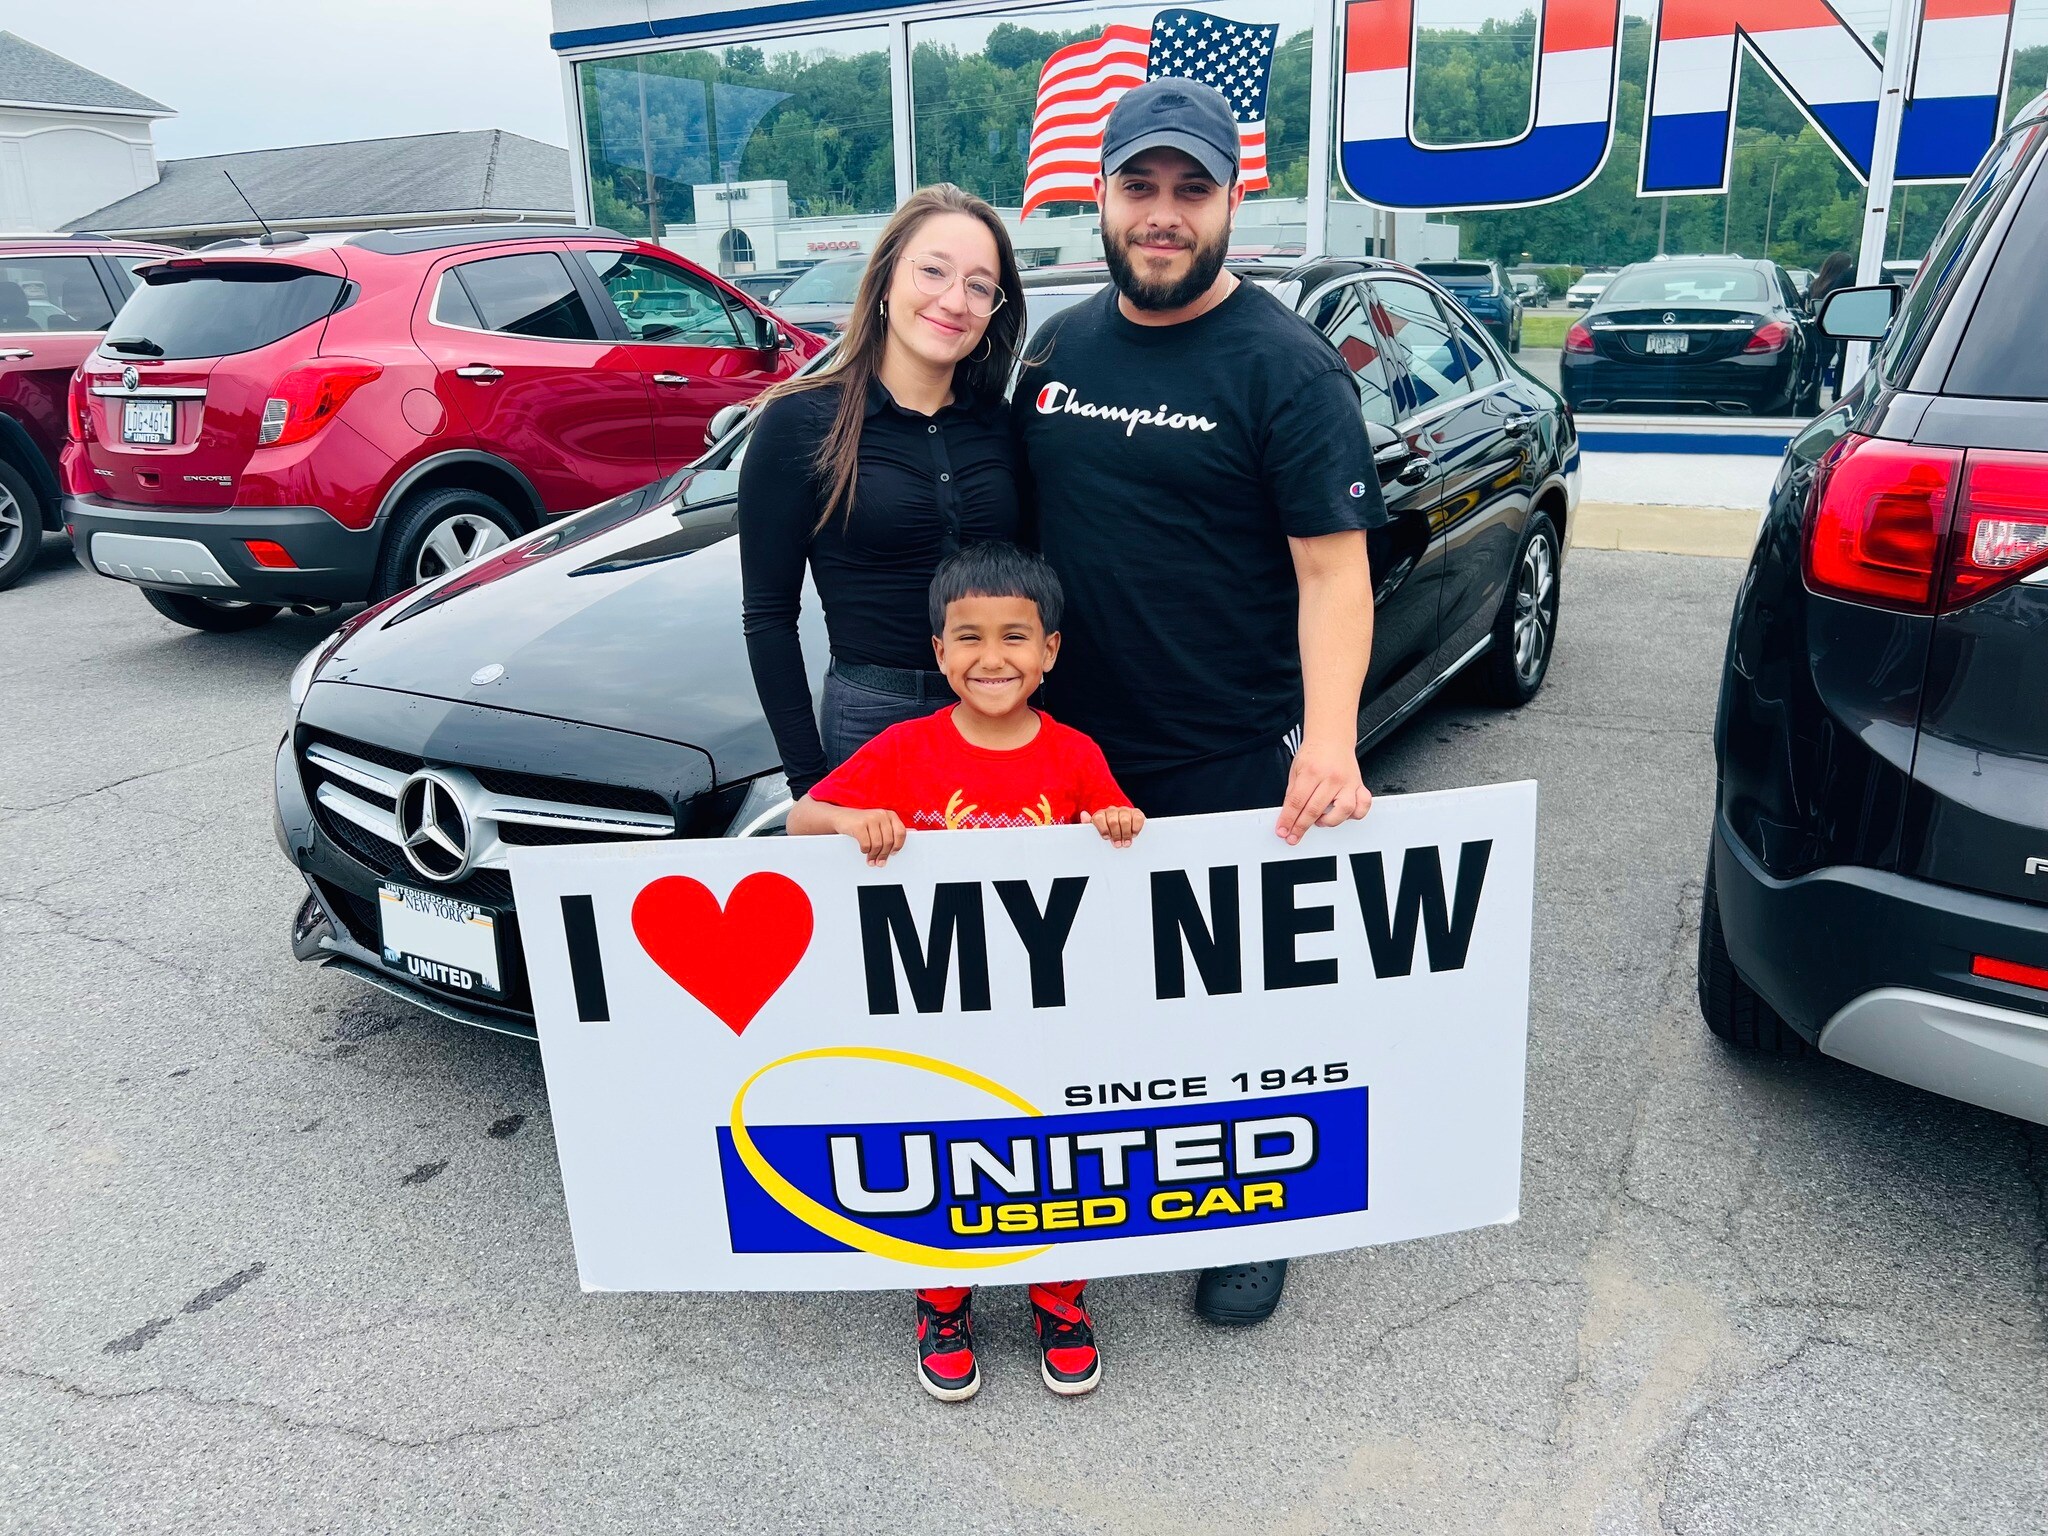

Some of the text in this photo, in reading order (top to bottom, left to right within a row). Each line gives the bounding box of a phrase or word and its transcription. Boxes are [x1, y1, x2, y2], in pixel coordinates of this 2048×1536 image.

[1035, 381, 1217, 437] Champion
[133, 433, 160, 442] UNITED
[385, 882, 480, 914] UNITEDUSEDCARS.COM
[406, 895, 466, 924] NEW YORK
[560, 839, 1493, 1022] I MY NEW
[407, 955, 473, 990] UNITED
[1064, 1061, 1349, 1107] SINCE 1945
[828, 1115, 1316, 1215] UNITED
[949, 1180, 1286, 1236] USED CAR
